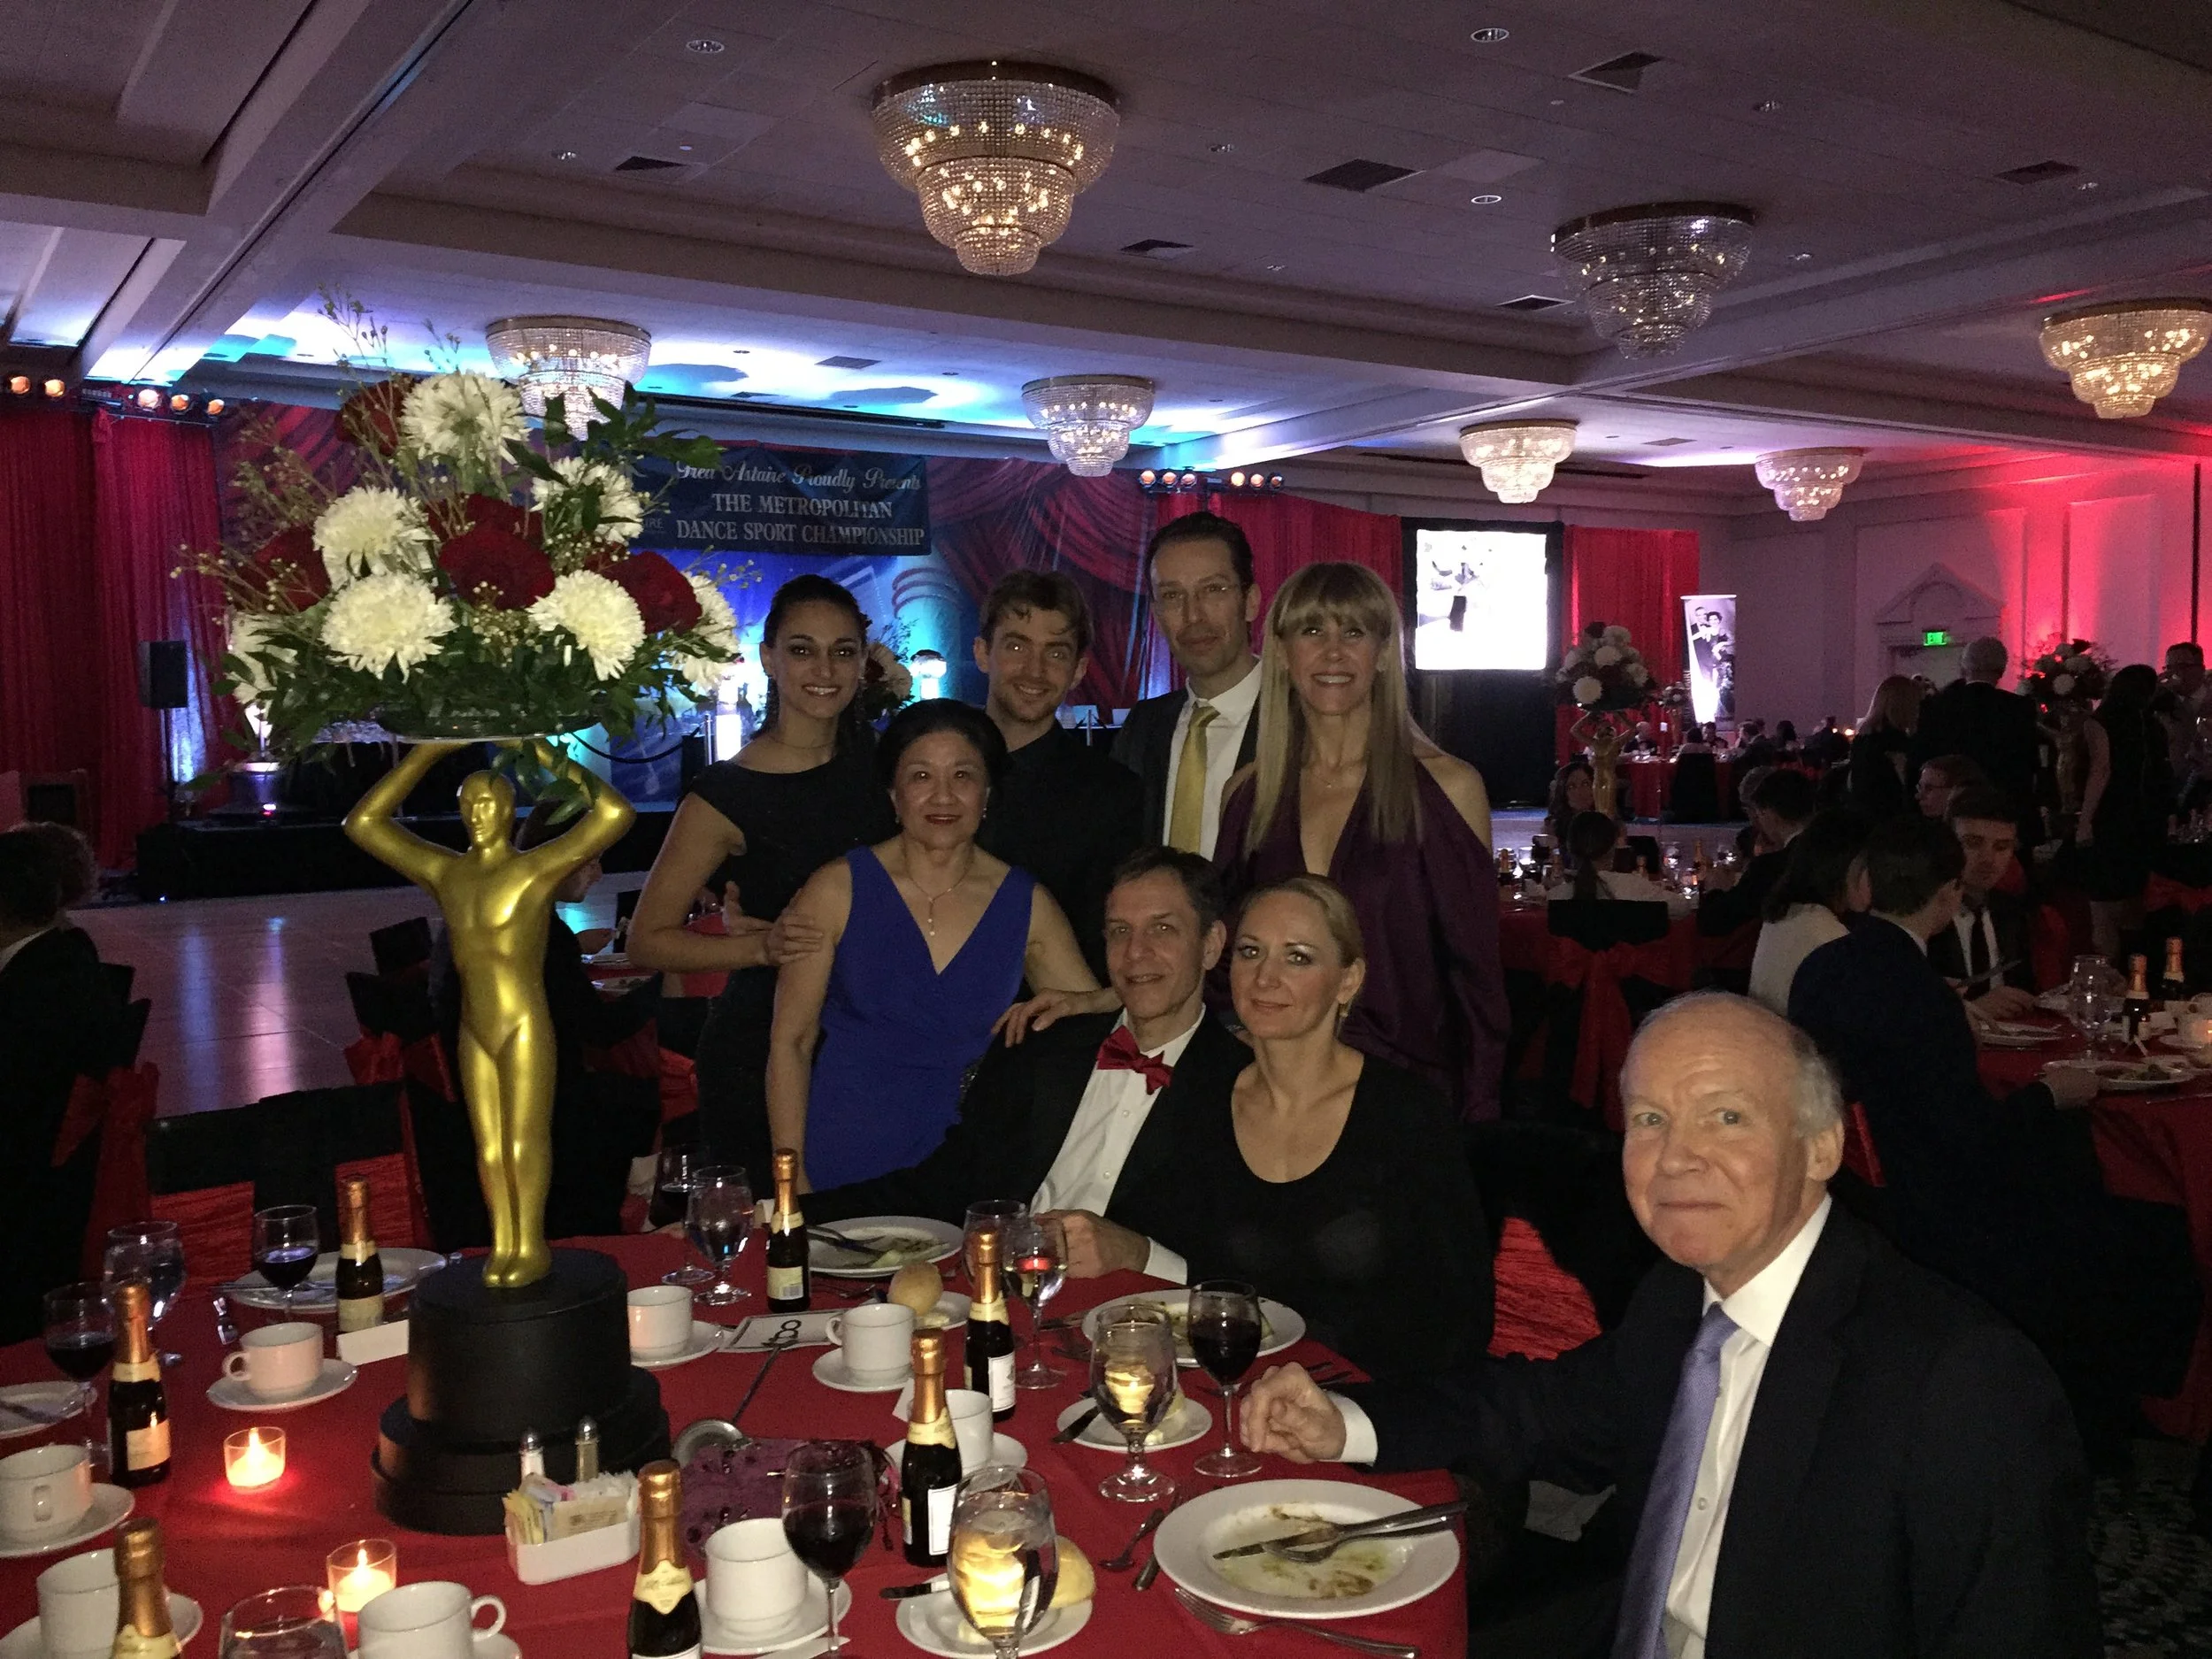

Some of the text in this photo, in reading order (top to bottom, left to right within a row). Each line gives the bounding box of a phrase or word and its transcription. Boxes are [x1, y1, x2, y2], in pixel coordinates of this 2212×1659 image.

[721, 461, 786, 484] Astaire
[791, 464, 856, 494] Proudly
[711, 493, 893, 518] THE METROPOLITAN
[676, 519, 926, 546] DANCE SPORT CHAMPIONSHIP
